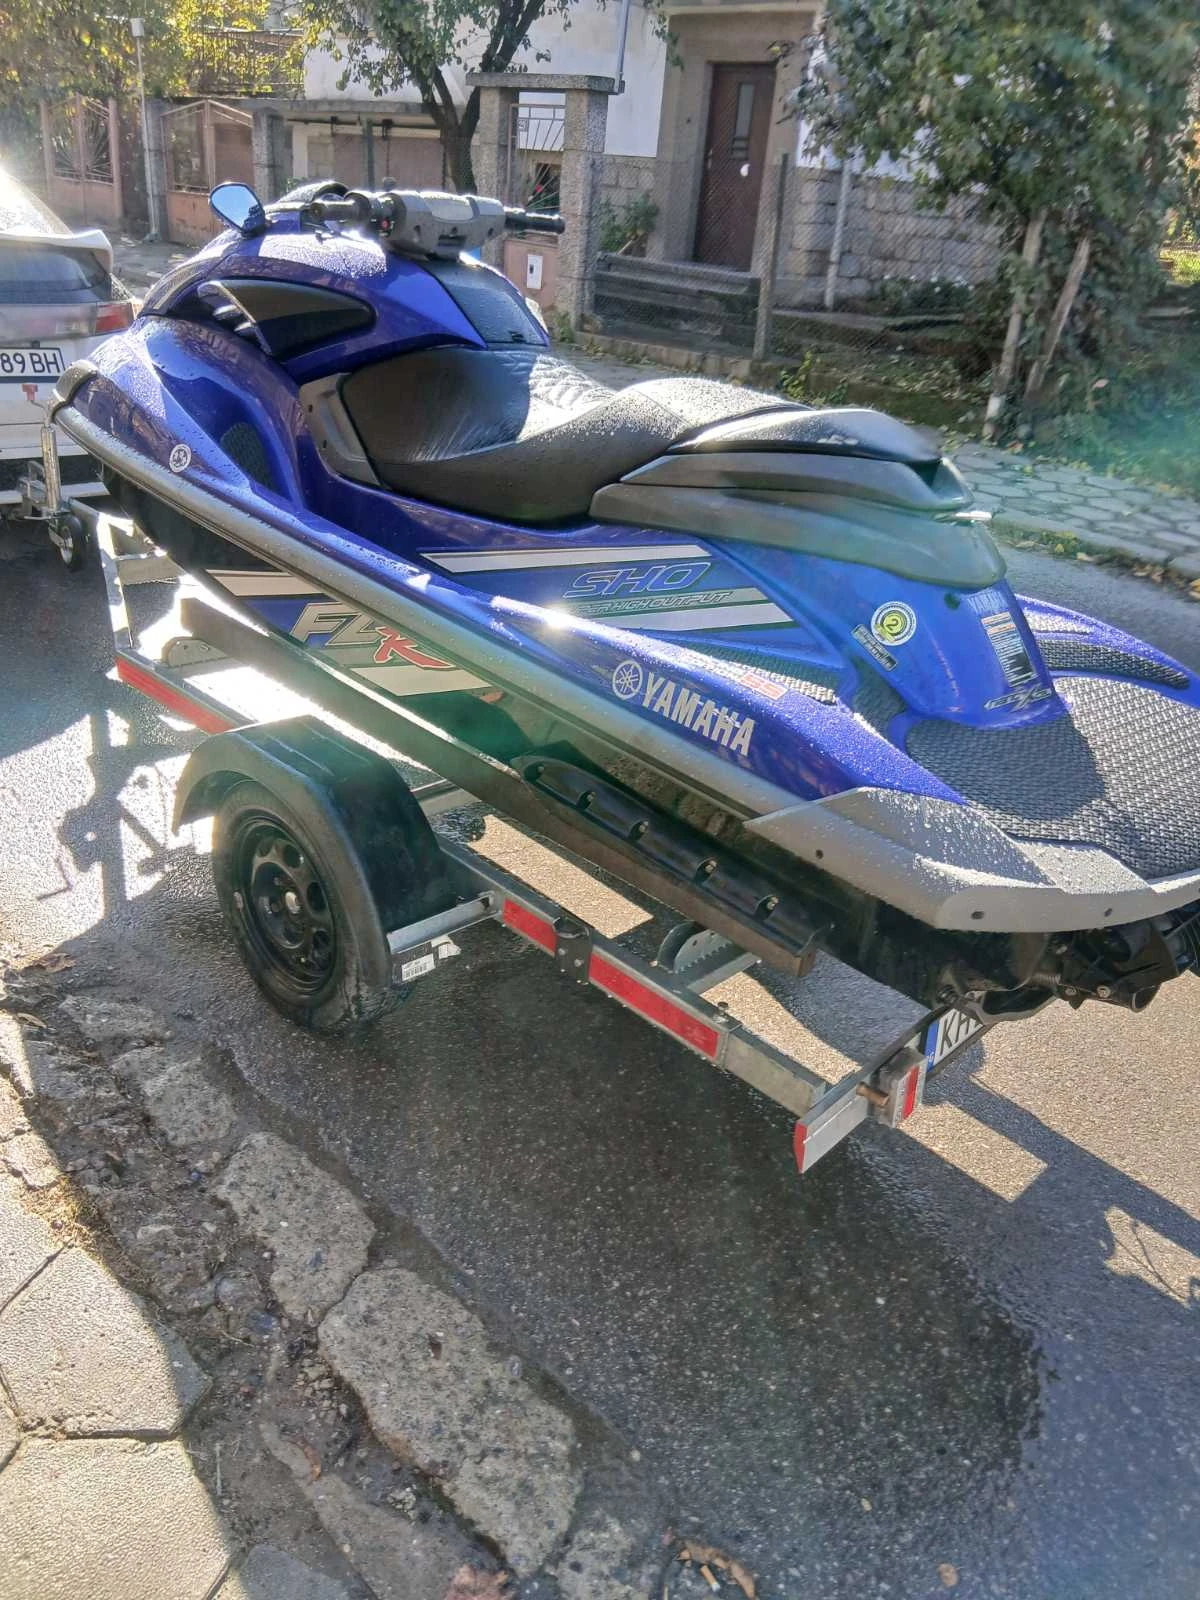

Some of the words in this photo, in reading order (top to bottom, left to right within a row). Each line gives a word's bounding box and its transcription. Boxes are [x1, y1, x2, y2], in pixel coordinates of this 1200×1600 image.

[0, 352, 26, 374] 89
[29, 352, 61, 374] BH
[562, 561, 712, 599] SHO
[614, 598, 652, 615] HIGH
[649, 590, 734, 609] OUTPUT
[643, 671, 756, 757] YAMAHA
